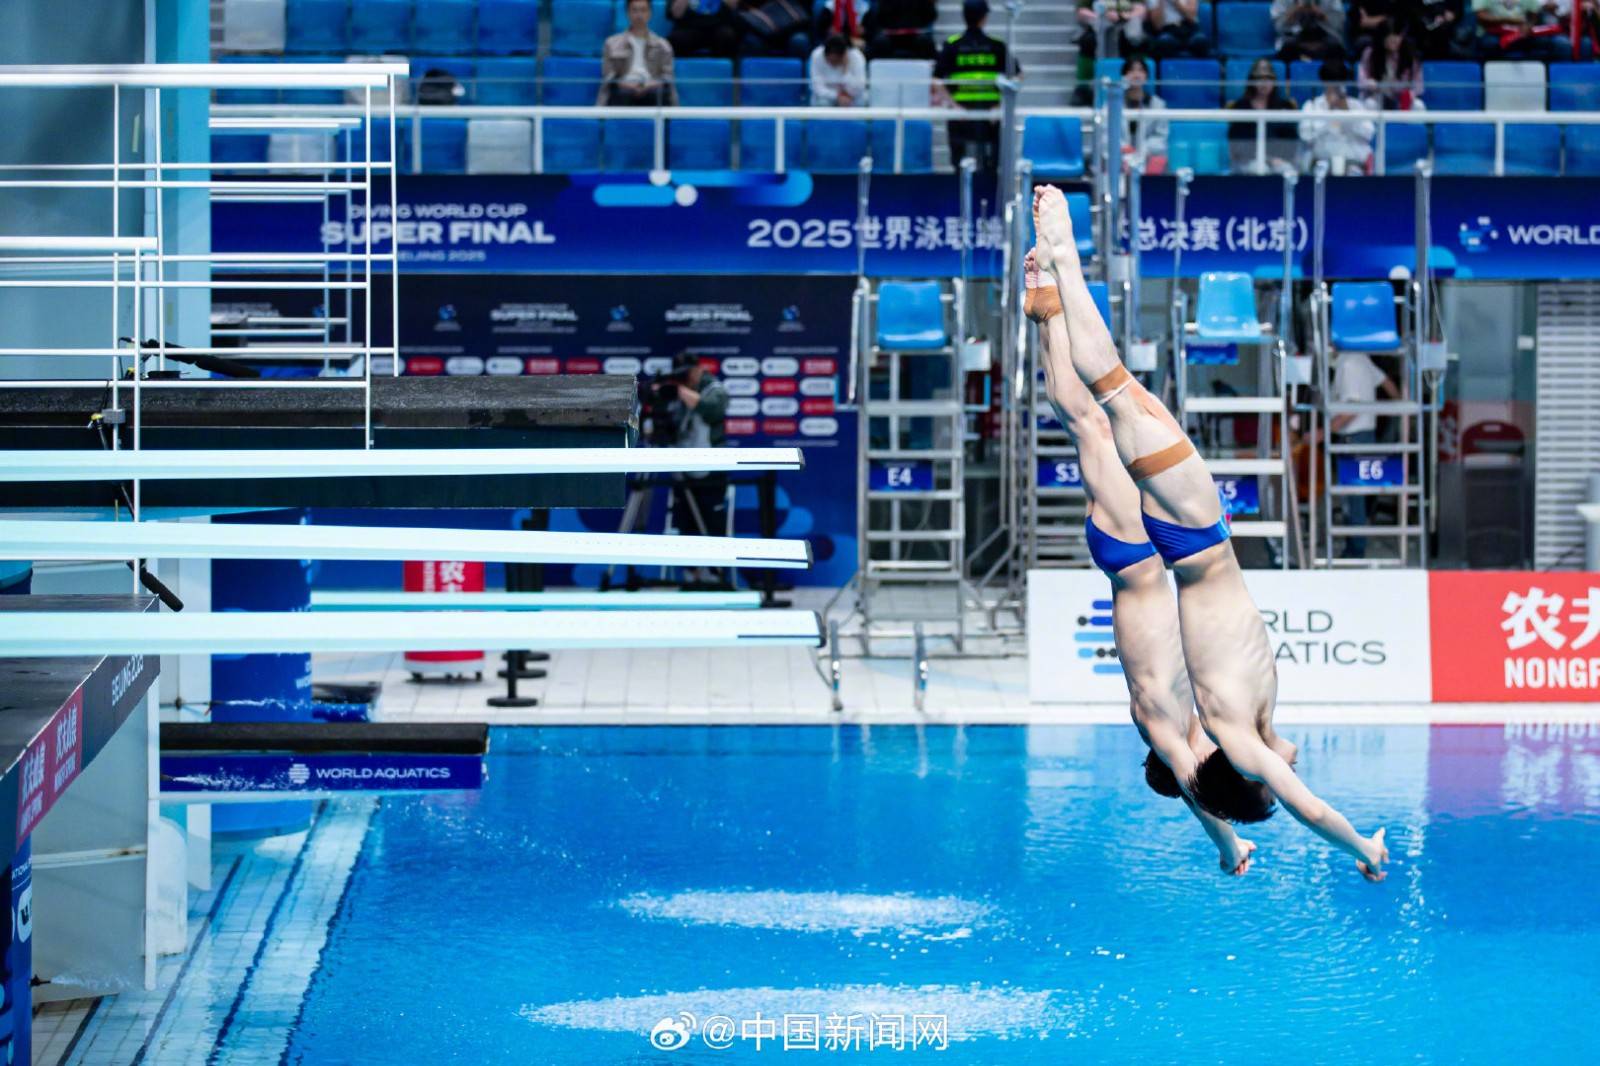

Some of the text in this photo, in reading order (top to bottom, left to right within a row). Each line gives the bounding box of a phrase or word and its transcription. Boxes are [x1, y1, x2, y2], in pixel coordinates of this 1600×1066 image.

[414, 203, 484, 218] WORLD
[486, 203, 528, 218] CUP
[320, 221, 556, 244] SUPER FINAL
[1120, 216, 1309, 251] 总决赛(北京)
[1507, 224, 1600, 245] WORLD
[398, 250, 446, 262] EIJING
[887, 467, 913, 487] E4
[1055, 462, 1080, 483] S3
[1358, 460, 1384, 481] E6
[1504, 657, 1600, 689] NONGF
[316, 767, 451, 779] WORLD AQUATICS
